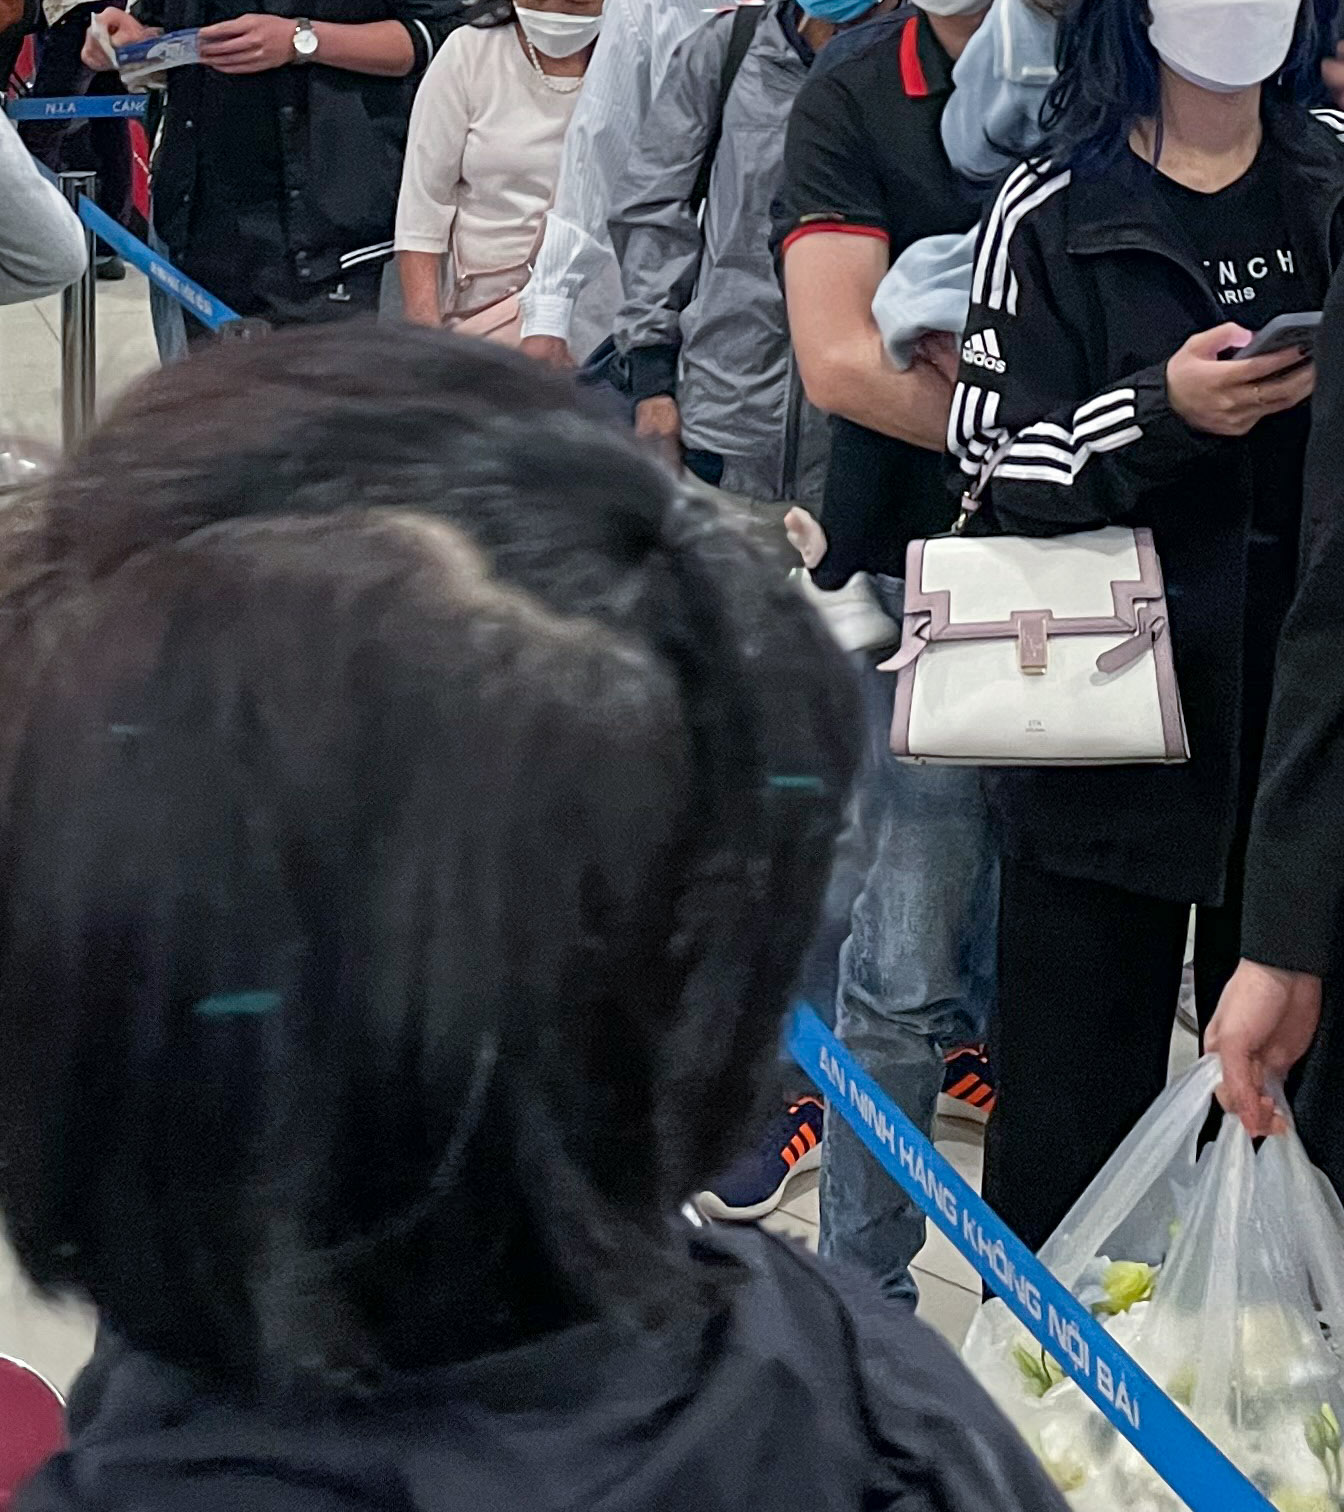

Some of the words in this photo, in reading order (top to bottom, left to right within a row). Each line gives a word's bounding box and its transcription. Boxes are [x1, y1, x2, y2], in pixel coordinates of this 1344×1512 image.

[1203, 249, 1294, 285] NCH
[819, 1045, 846, 1098] AN
[851, 1079, 896, 1155] NINH
[962, 1207, 1042, 1321] KHÔNG
[1047, 1302, 1090, 1377] NỘI
